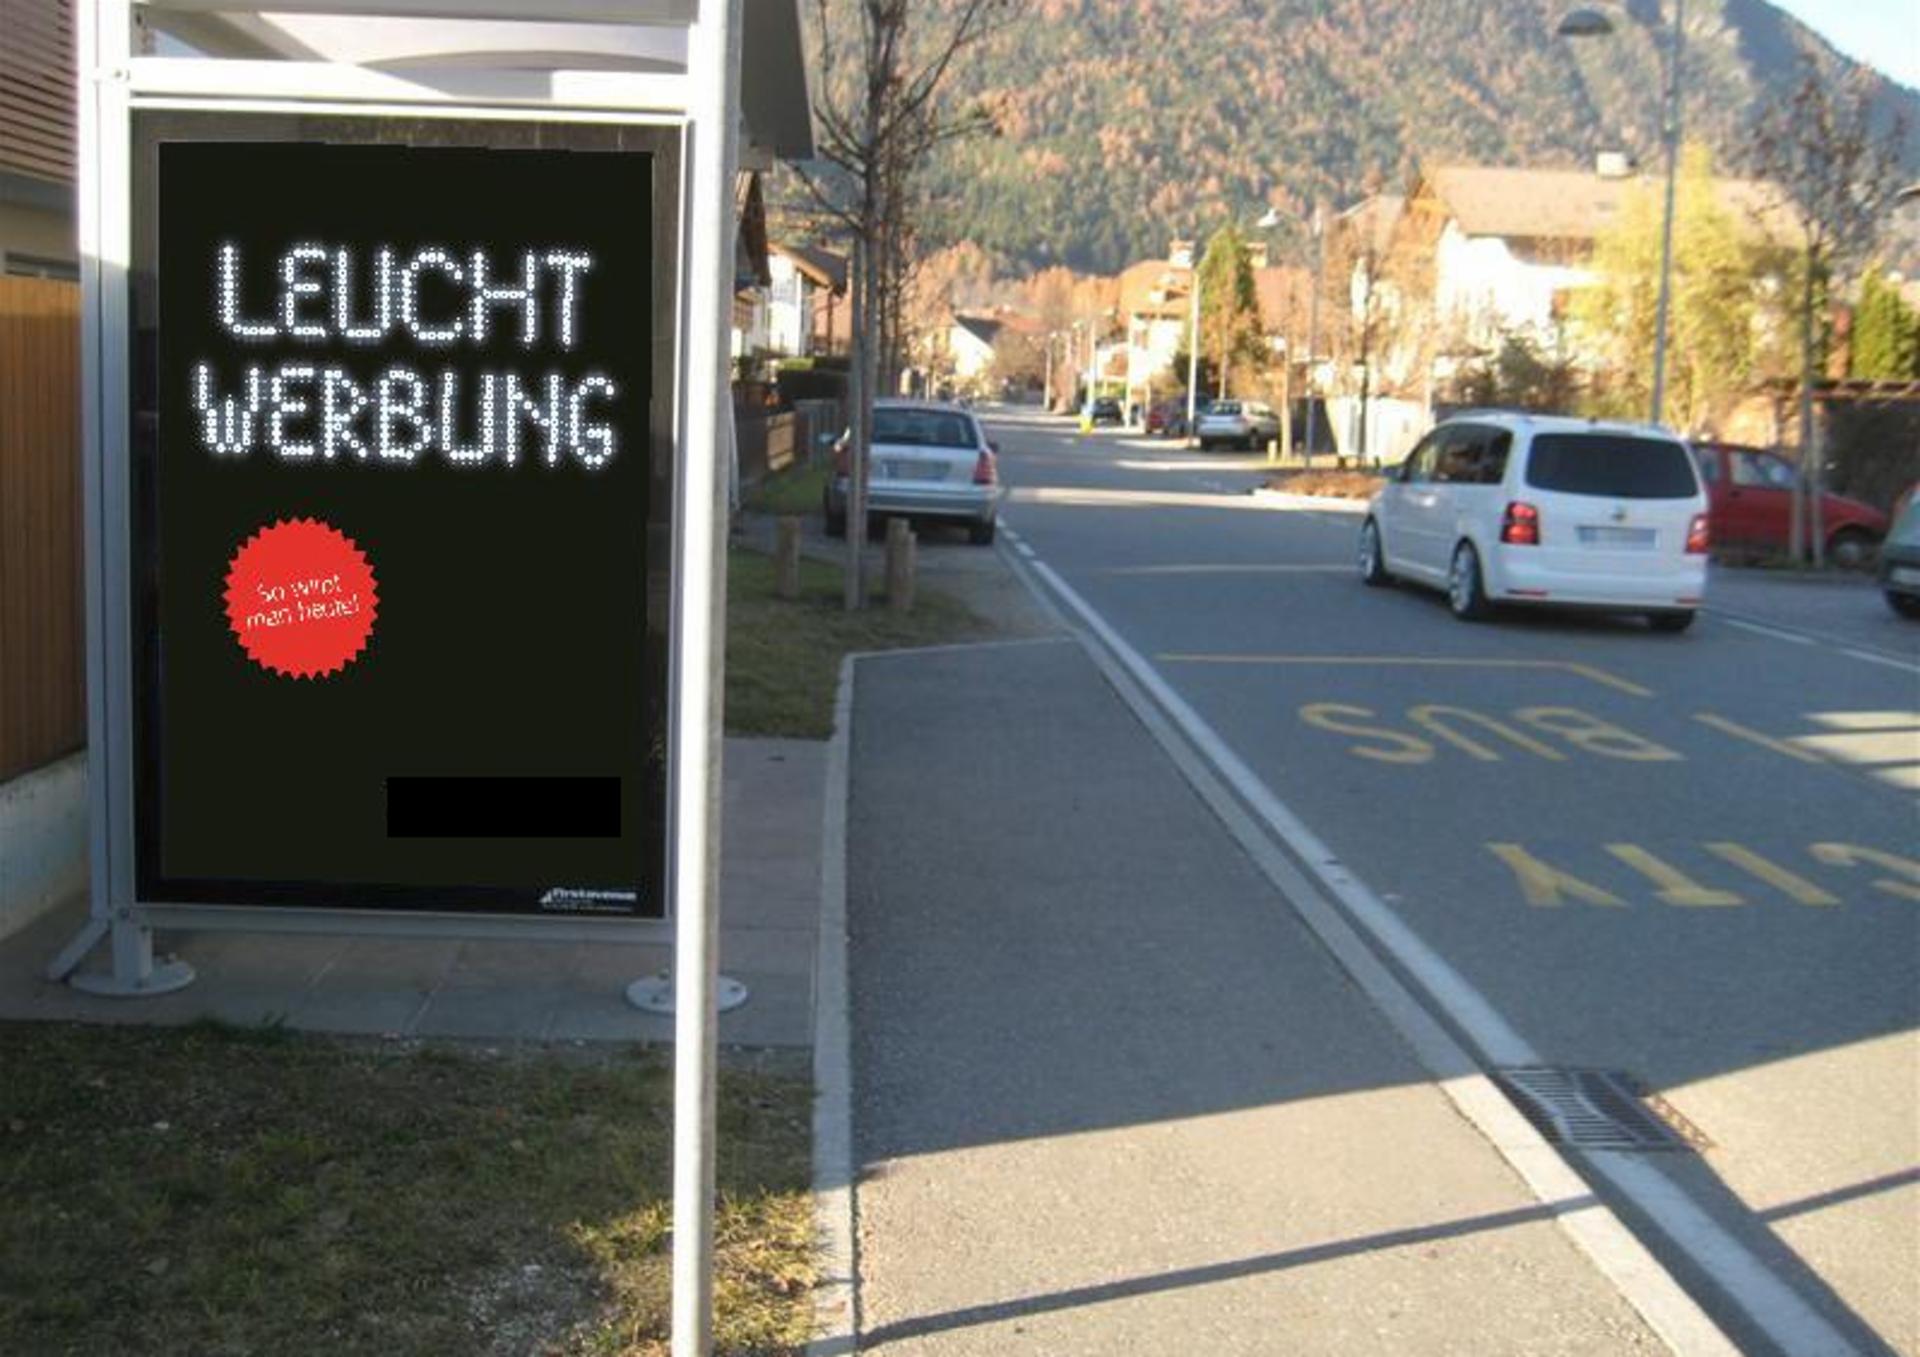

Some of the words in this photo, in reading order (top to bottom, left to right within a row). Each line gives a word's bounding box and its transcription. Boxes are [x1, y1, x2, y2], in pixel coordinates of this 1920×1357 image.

[215, 241, 592, 349] LEUCHT
[194, 361, 617, 469] WERBUNG
[1299, 702, 1690, 764] BUS
